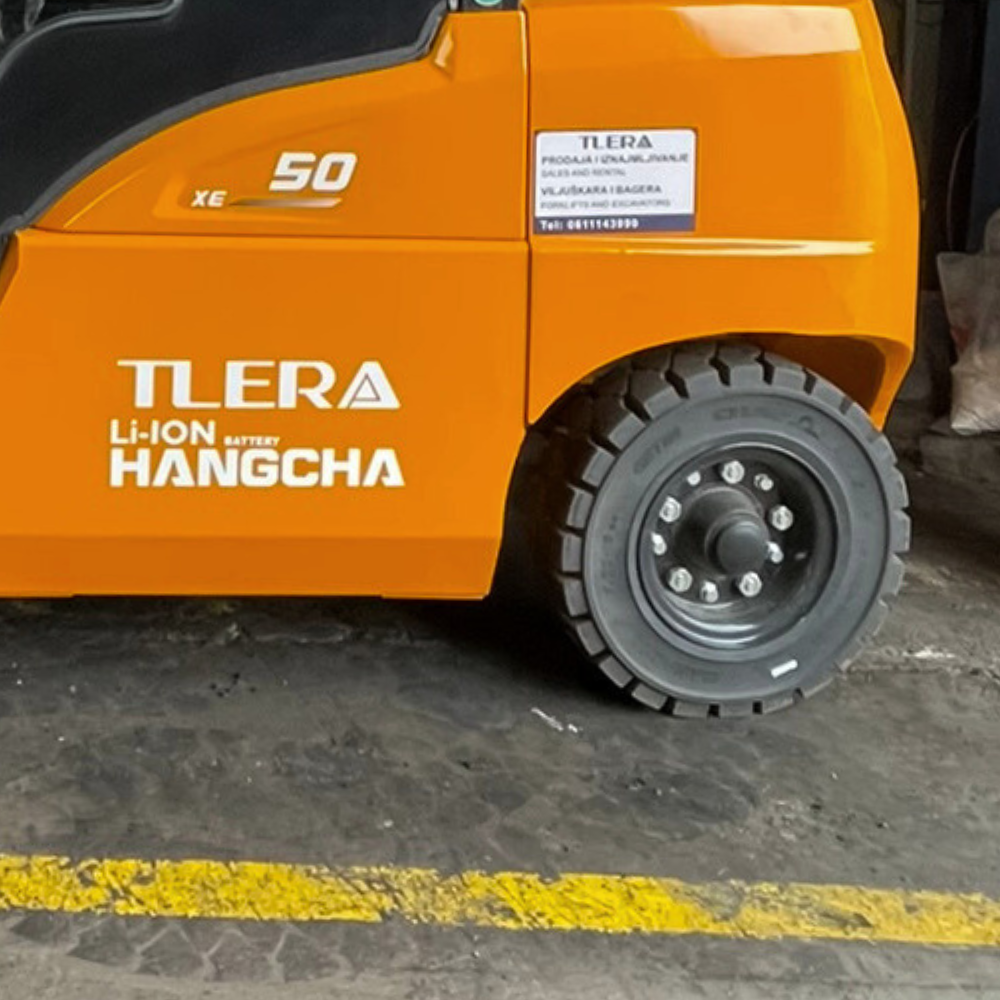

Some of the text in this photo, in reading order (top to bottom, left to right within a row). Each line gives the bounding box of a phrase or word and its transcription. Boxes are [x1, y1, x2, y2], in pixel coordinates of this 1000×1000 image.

[579, 134, 653, 149] TLERA
[268, 151, 358, 192] 50
[541, 156, 592, 165] PRODAJA
[190, 189, 228, 208] XE
[616, 184, 662, 194] BAGERA
[117, 359, 401, 410] TLERA
[110, 418, 280, 447] Li-ION BATTERY
[109, 447, 406, 488] HANGCHA
